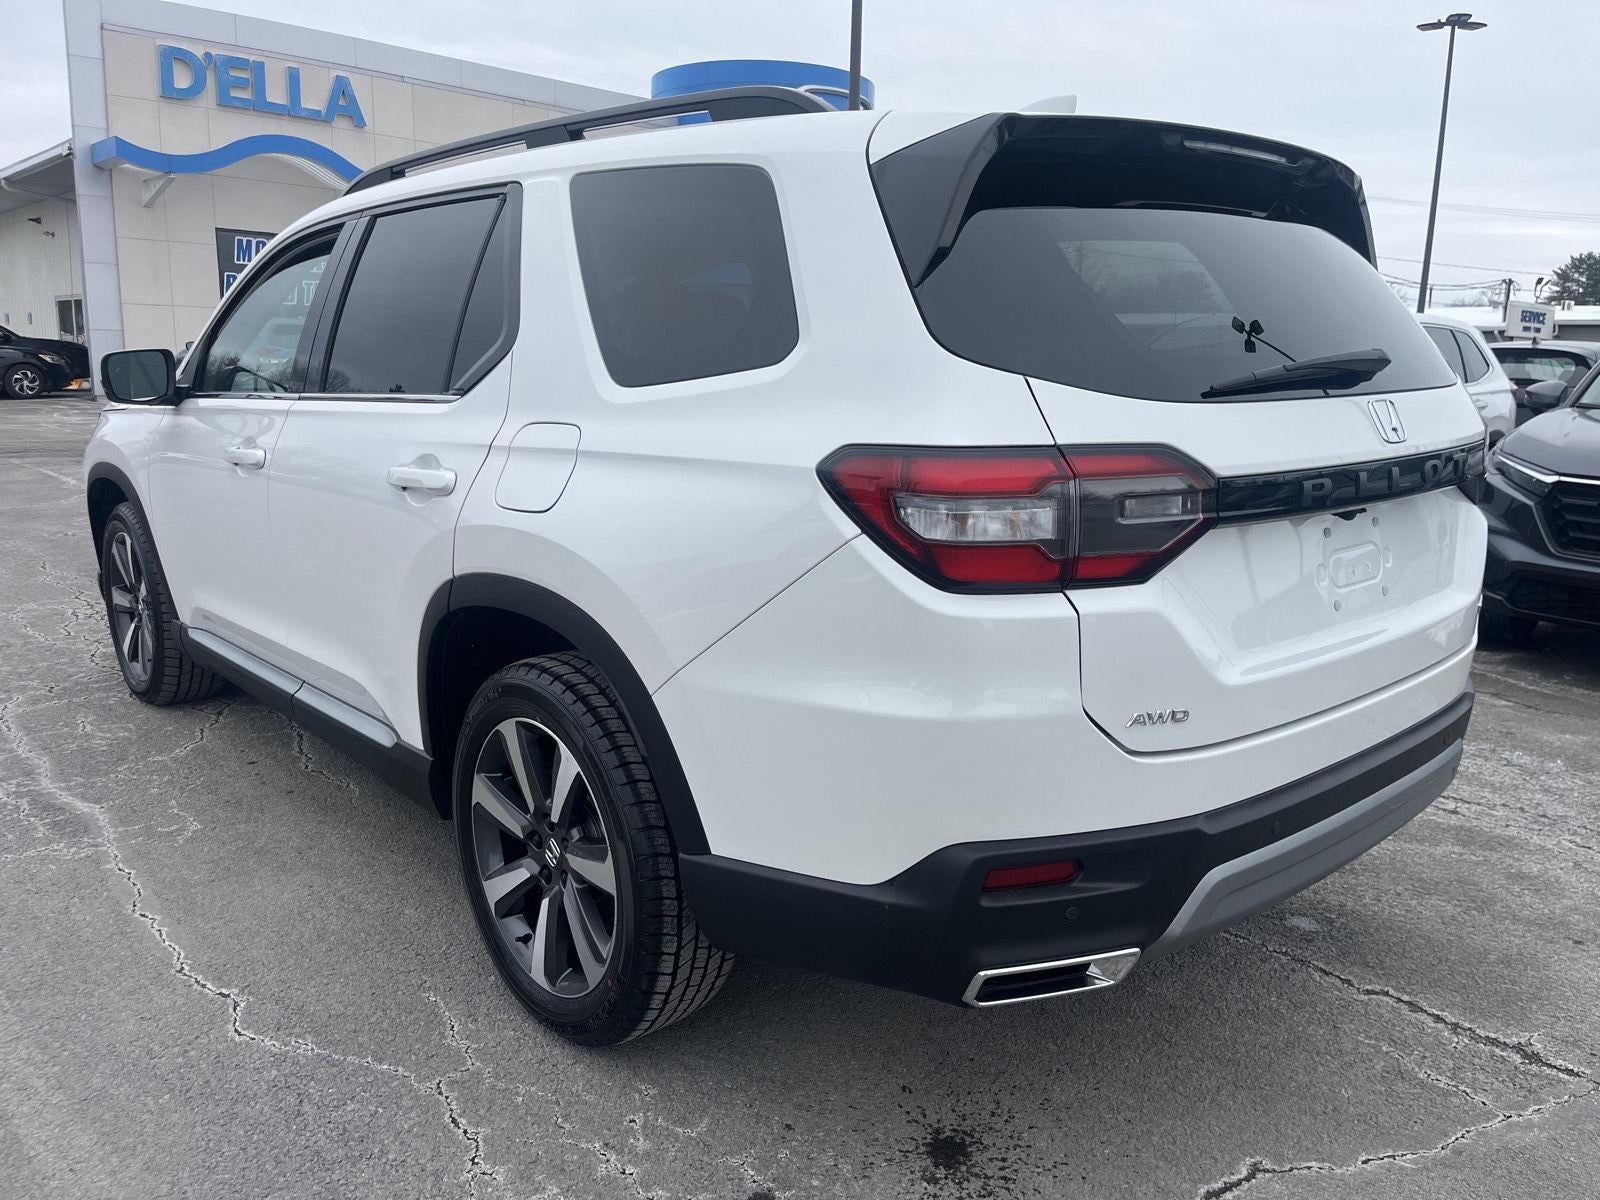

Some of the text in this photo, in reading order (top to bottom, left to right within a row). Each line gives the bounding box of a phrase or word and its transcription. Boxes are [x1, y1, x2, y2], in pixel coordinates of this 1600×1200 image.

[158, 43, 367, 128] D'ELLA
[1521, 310, 1546, 325] SERVICE
[1302, 452, 1468, 507] PILOT
[1125, 709, 1190, 728] AWD
